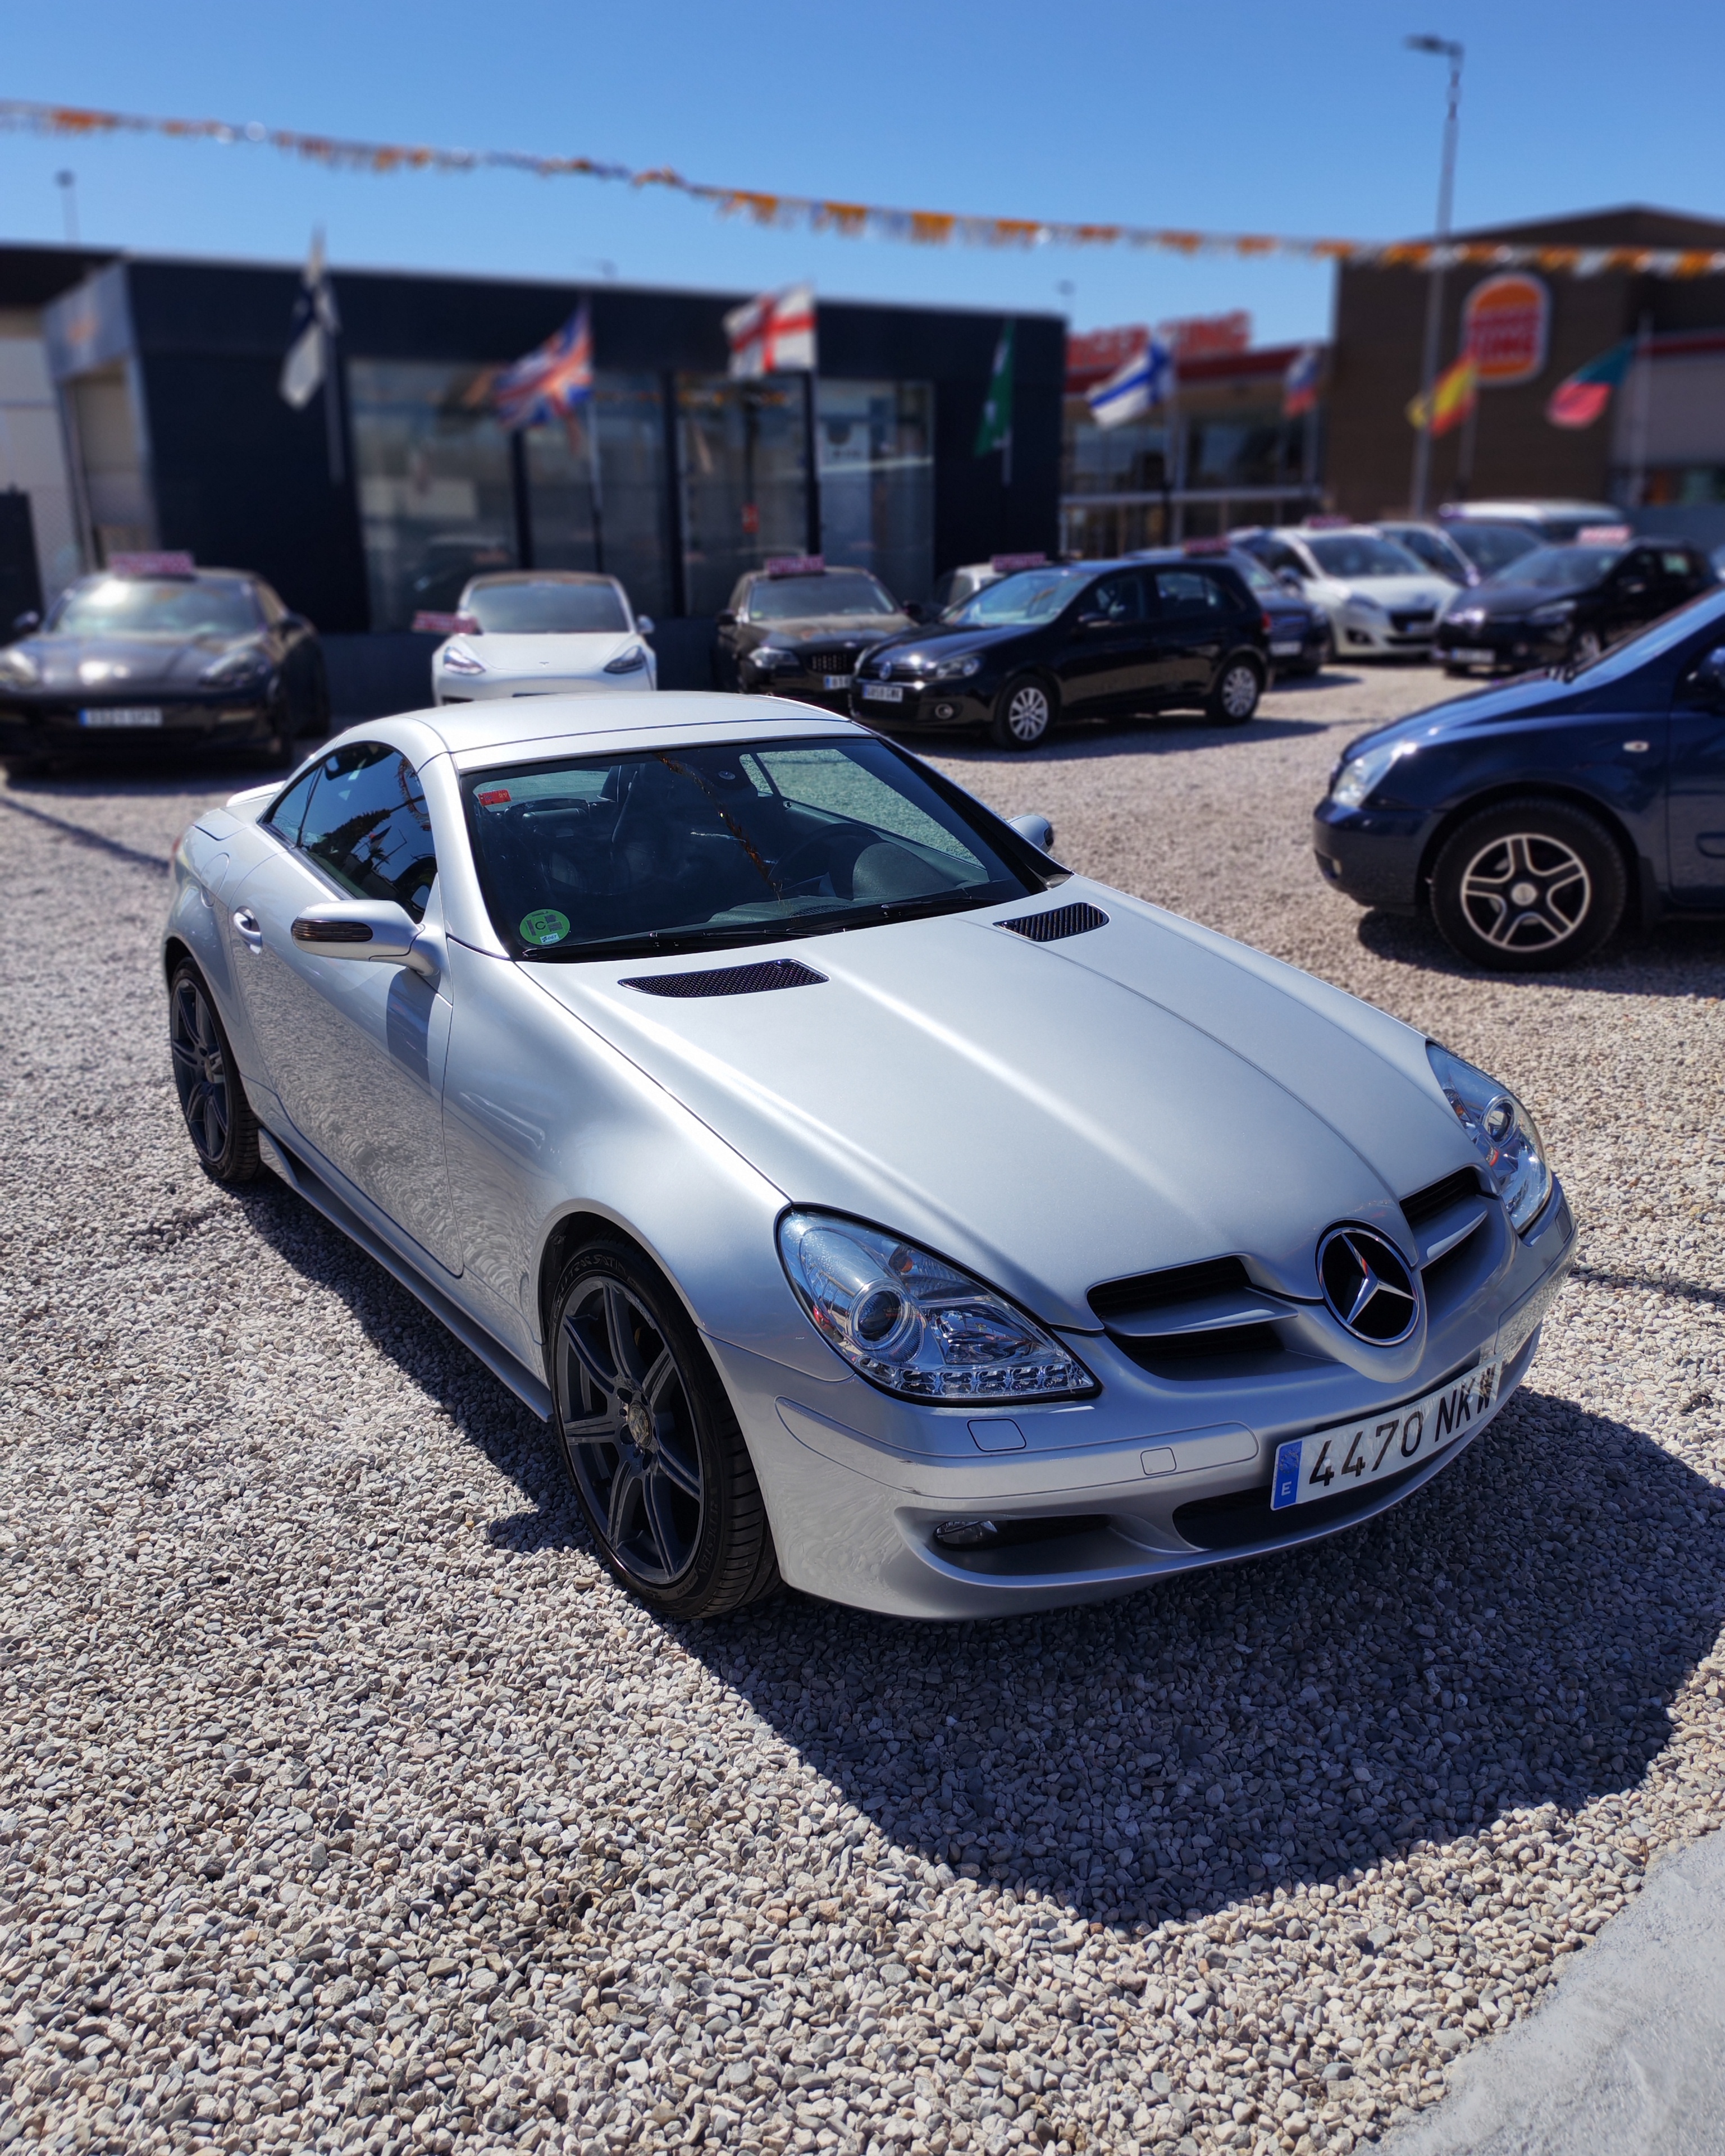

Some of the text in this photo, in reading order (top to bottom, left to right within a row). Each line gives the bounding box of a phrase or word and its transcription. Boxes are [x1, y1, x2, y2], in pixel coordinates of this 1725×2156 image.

[535, 921, 546, 930] C
[1308, 1363, 1497, 1487] 4470 NKW
[1281, 1481, 1292, 1496] E
